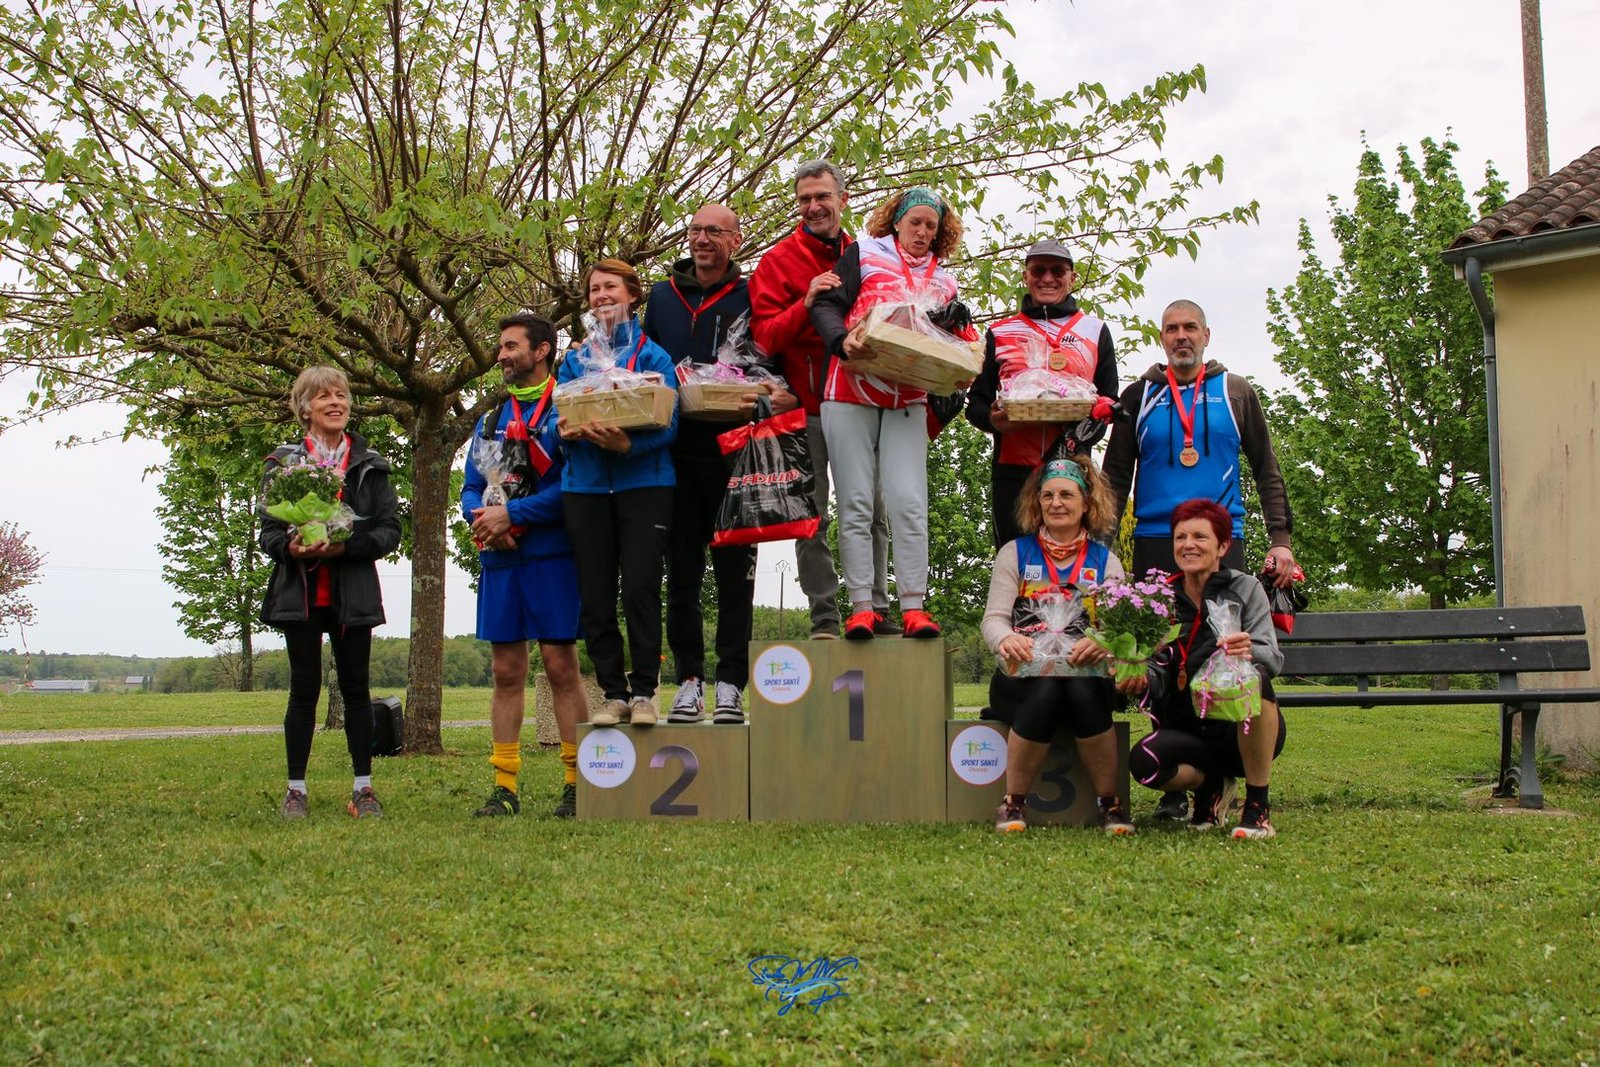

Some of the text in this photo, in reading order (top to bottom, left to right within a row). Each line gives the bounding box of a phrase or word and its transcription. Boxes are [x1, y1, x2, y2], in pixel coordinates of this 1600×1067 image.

[727, 468, 801, 489] SADIUM
[763, 675, 801, 686] SPORT SANTÉ
[832, 670, 865, 742] 1
[588, 759, 625, 769] SPORT SANTÉ
[960, 756, 999, 767] SPORT SANTÉ
[648, 744, 699, 817] 2
[1026, 744, 1077, 814] 3
